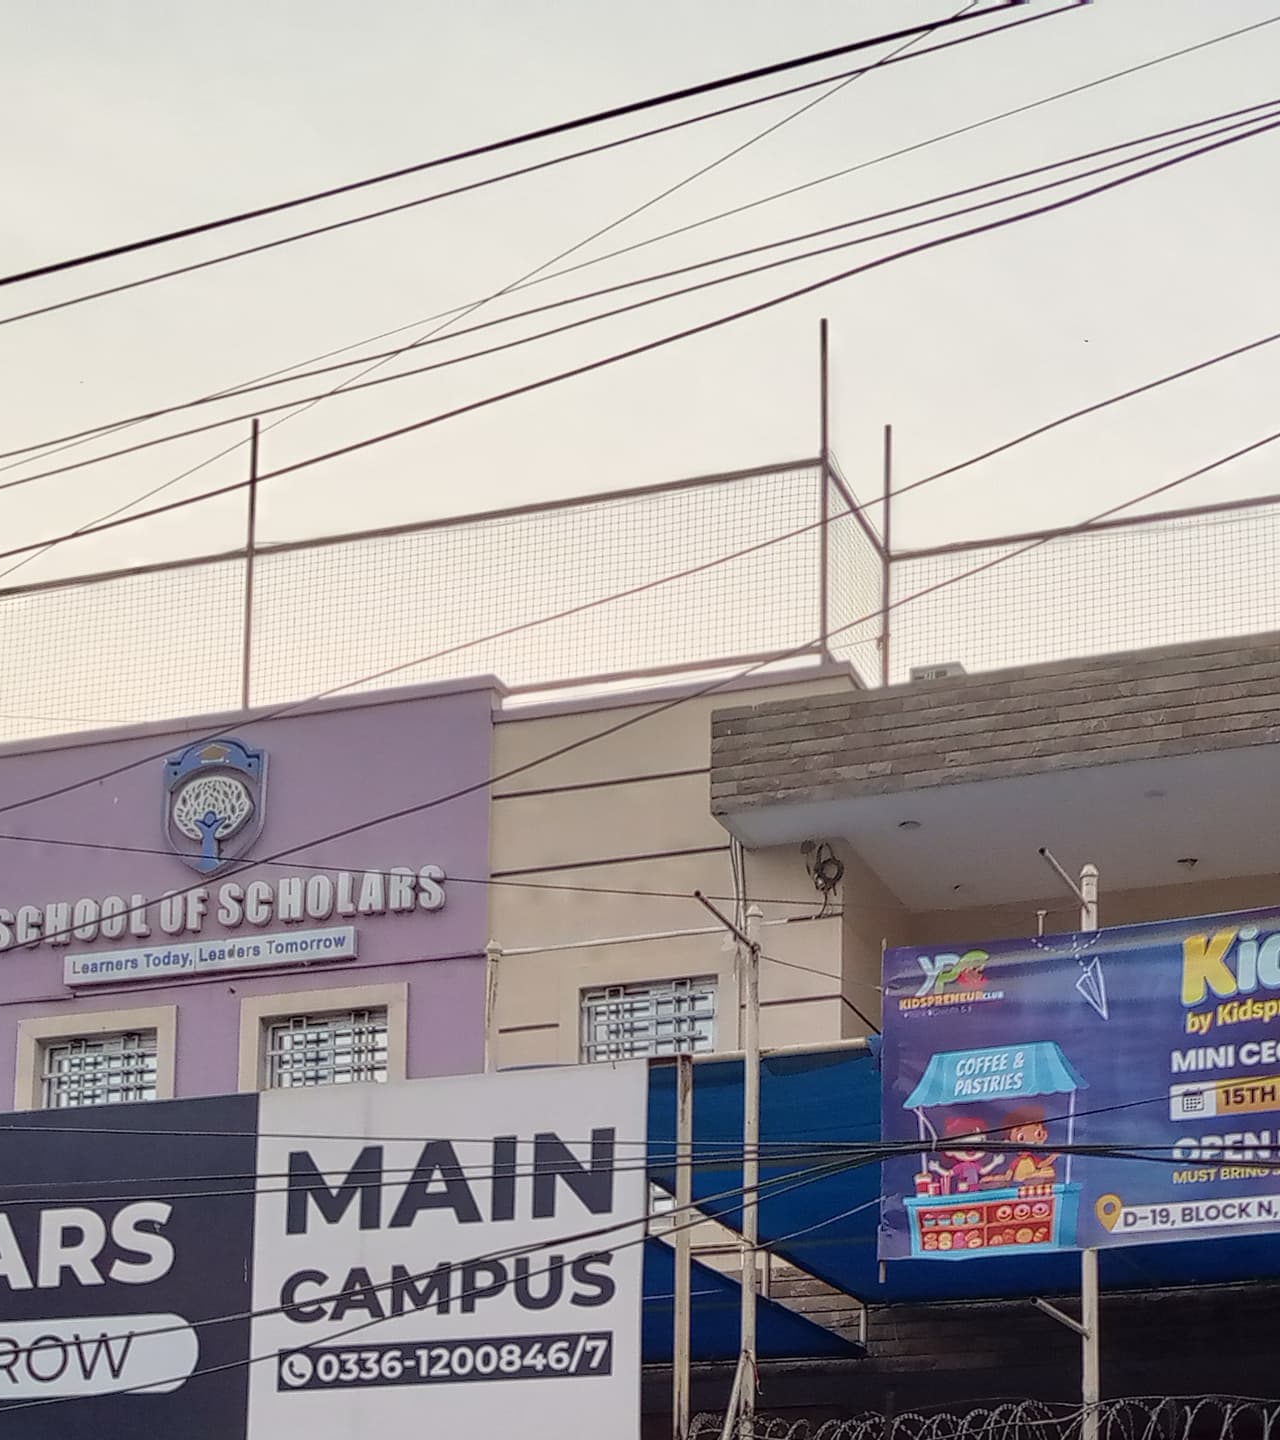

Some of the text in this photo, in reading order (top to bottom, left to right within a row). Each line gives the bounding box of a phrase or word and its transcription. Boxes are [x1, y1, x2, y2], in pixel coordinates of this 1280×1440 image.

[160, 888, 208, 936] OF
[219, 864, 447, 927] SCHOLARS
[72, 933, 346, 974] Learners Today, Leaders Tomorrow
[1185, 1011, 1213, 1034] by
[956, 1051, 1024, 1077] COFFEE &
[1171, 1044, 1235, 1073] MINI
[954, 1072, 1023, 1096] PASTRIES
[1223, 1082, 1275, 1105] 15TH
[1173, 1130, 1270, 1162] OPEN
[286, 1127, 616, 1236] MAIN
[1173, 1168, 1217, 1184] MUST
[1181, 1201, 1251, 1223] BLOCK
[1257, 1199, 1279, 1219] N,
[279, 1251, 616, 1324] CAMPUS
[316, 1335, 608, 1382] 0336-1200846/7
